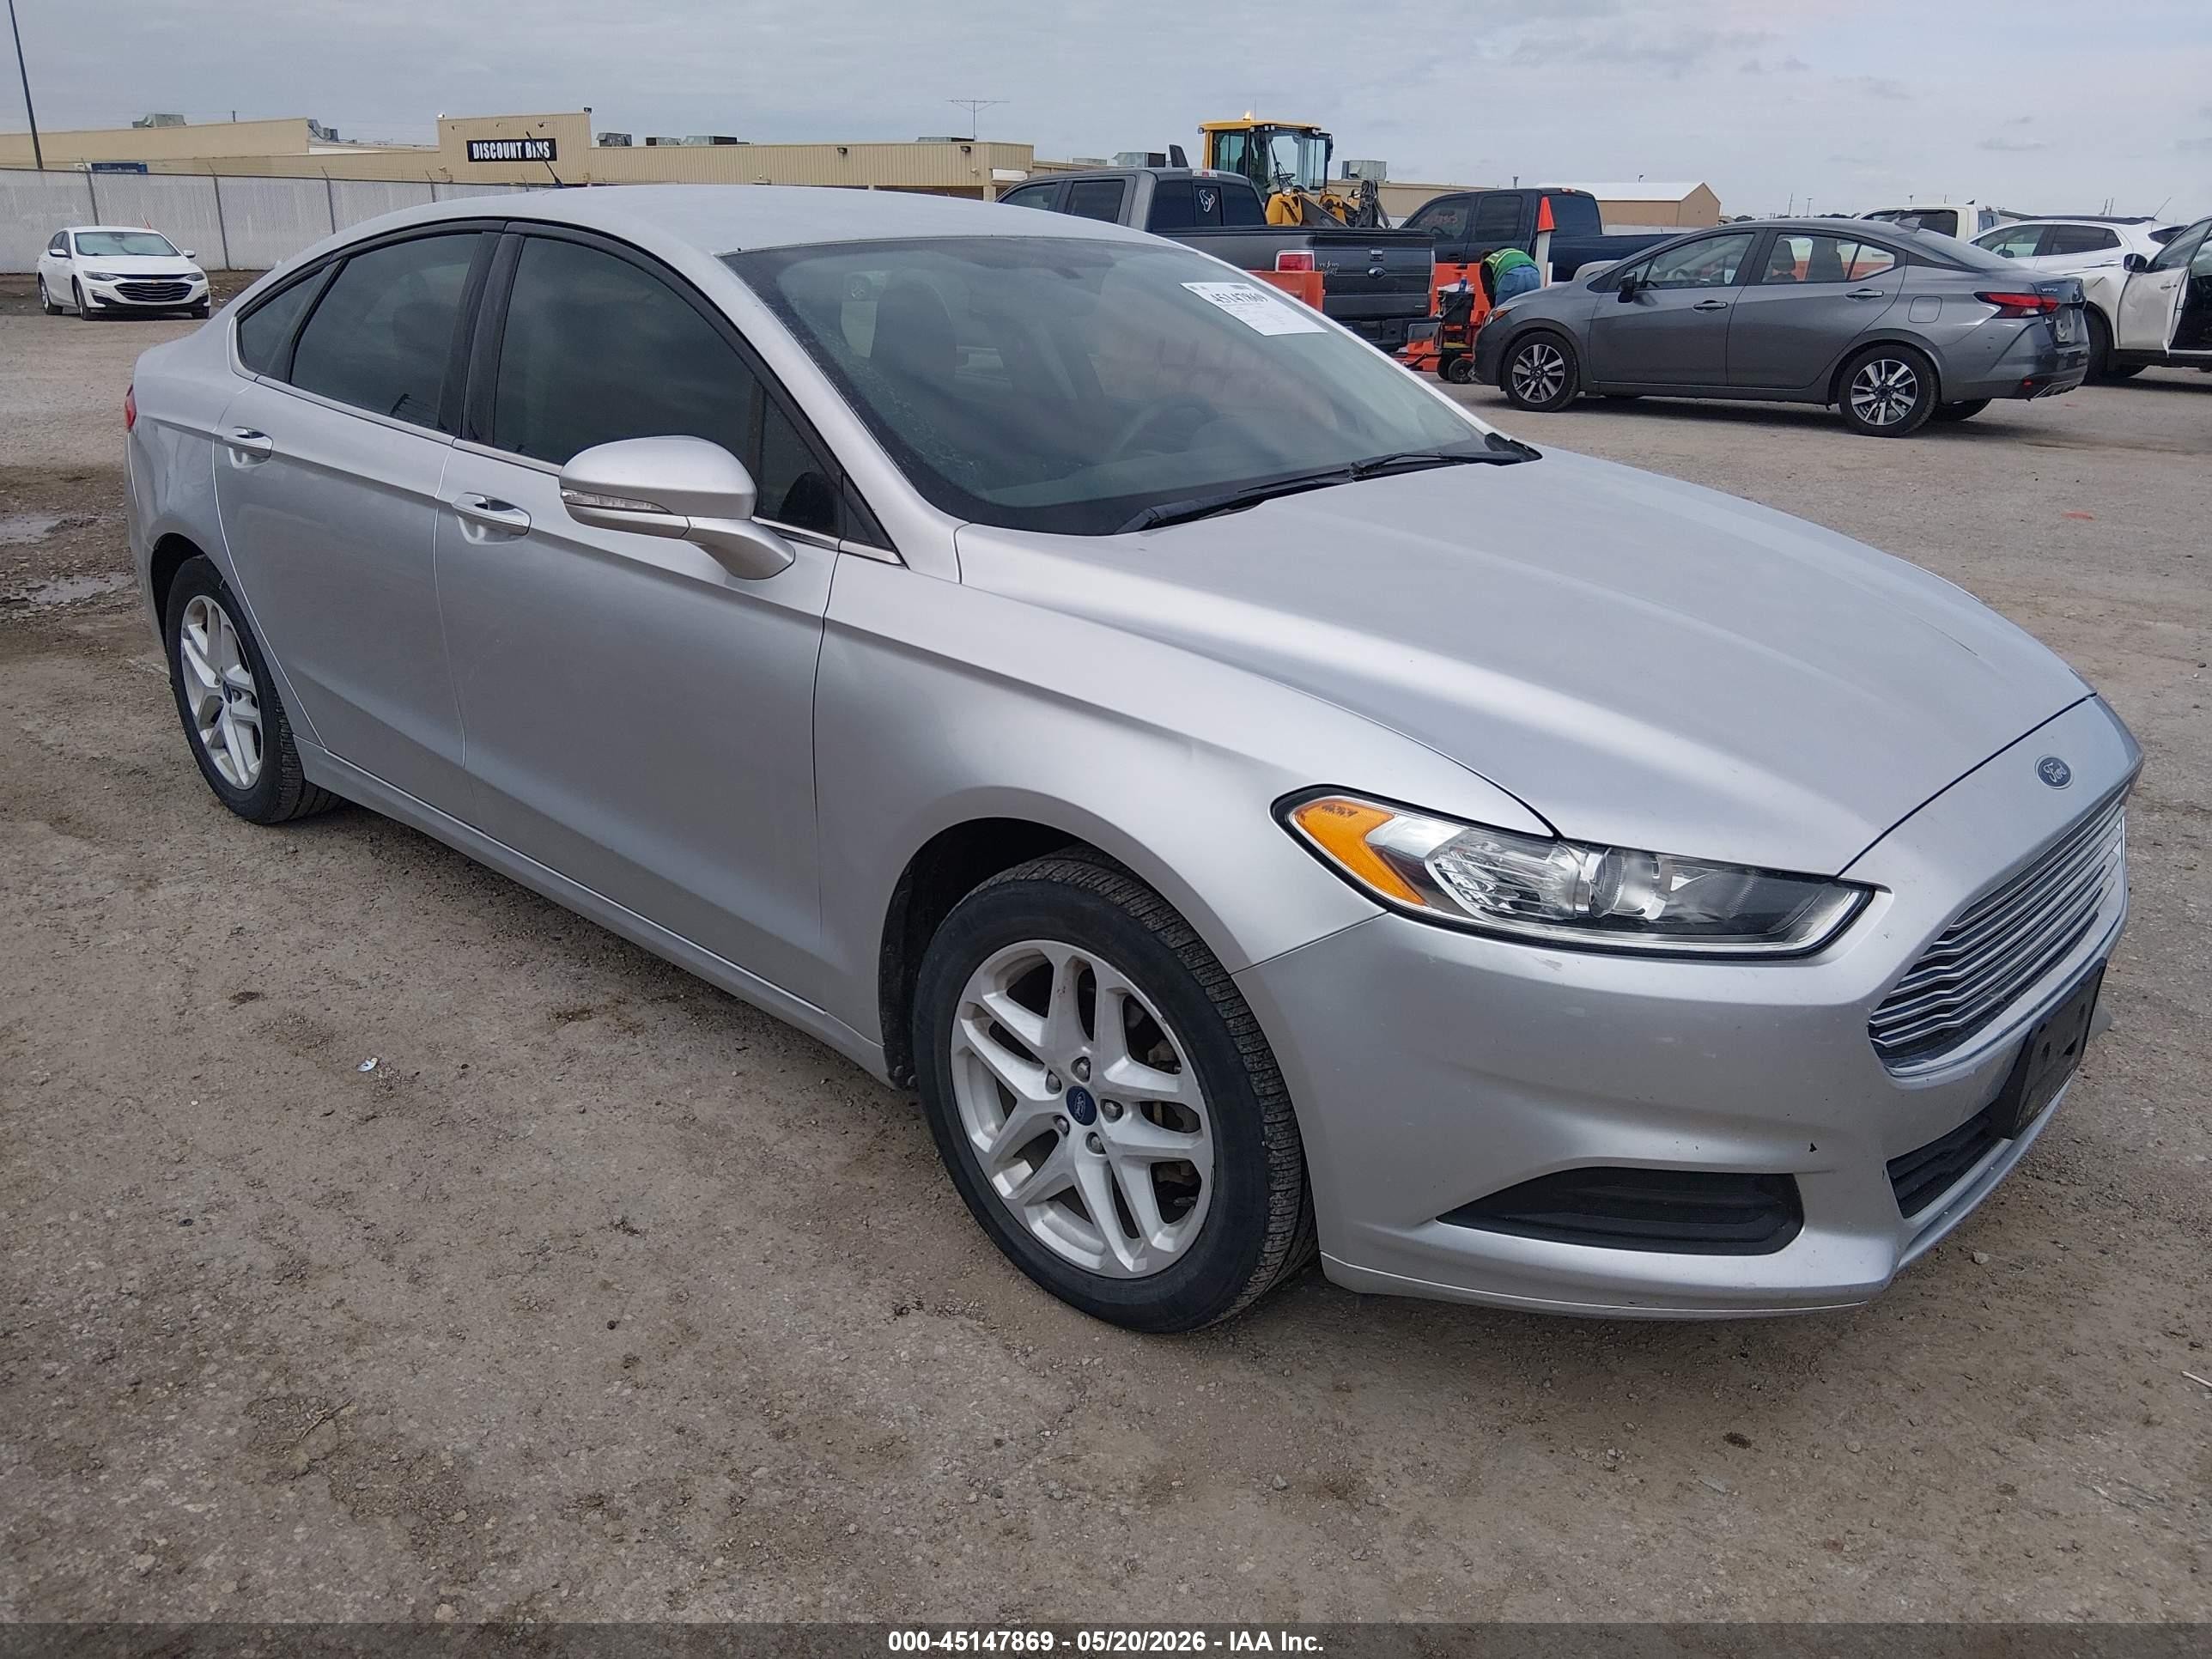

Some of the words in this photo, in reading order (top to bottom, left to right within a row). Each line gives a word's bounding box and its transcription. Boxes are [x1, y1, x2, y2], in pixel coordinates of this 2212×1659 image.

[472, 142, 522, 160] DISCOUNT
[1210, 293, 1268, 303] 45147869
[2042, 762, 2068, 783] Ford
